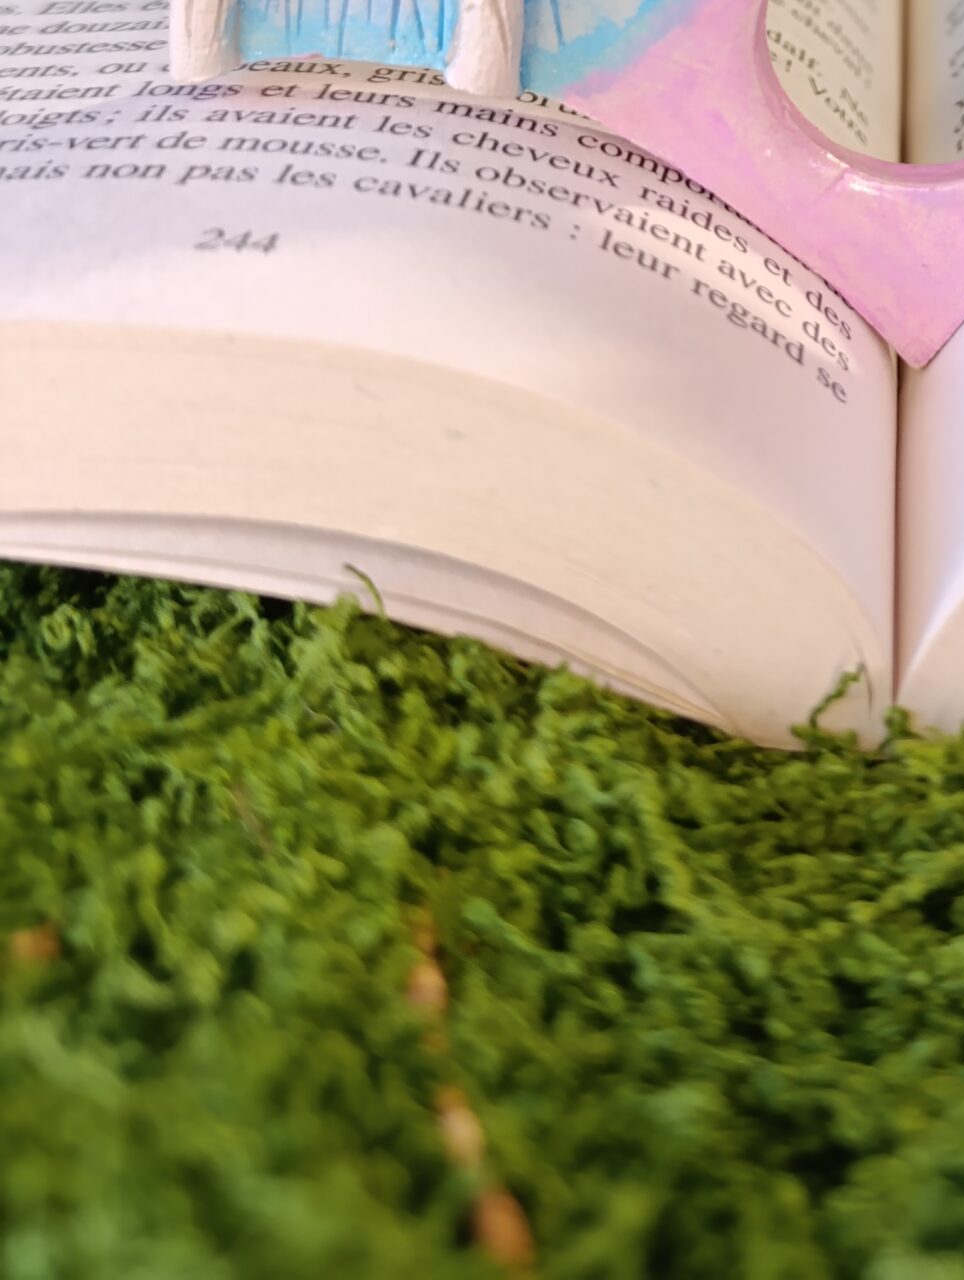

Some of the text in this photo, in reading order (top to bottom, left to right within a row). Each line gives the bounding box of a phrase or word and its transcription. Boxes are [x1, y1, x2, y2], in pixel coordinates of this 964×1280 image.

[38, 1, 131, 16] Elles
[97, 61, 149, 75] ou
[130, 80, 243, 102] longs
[260, 83, 301, 98] et
[314, 83, 416, 108] leurs
[433, 100, 559, 138] mains
[133, 104, 190, 123] ils
[205, 106, 361, 131] avaient
[373, 114, 434, 139] les
[452, 131, 622, 189] cheveux
[638, 185, 749, 254] raides
[763, 256, 793, 287] et
[805, 289, 852, 341] des
[156, 130, 208, 152] de
[216, 135, 389, 164] mousse.
[404, 148, 462, 175] Ils
[475, 165, 709, 263] observaient
[716, 259, 794, 320] avec
[801, 319, 850, 372] des
[193, 225, 281, 256] 244
[79, 161, 169, 180] non
[174, 162, 260, 187] pas
[272, 163, 338, 189] les
[353, 173, 552, 231] cavaliers
[598, 228, 681, 281] leur
[690, 275, 806, 367] regard
[816, 365, 848, 404] se
